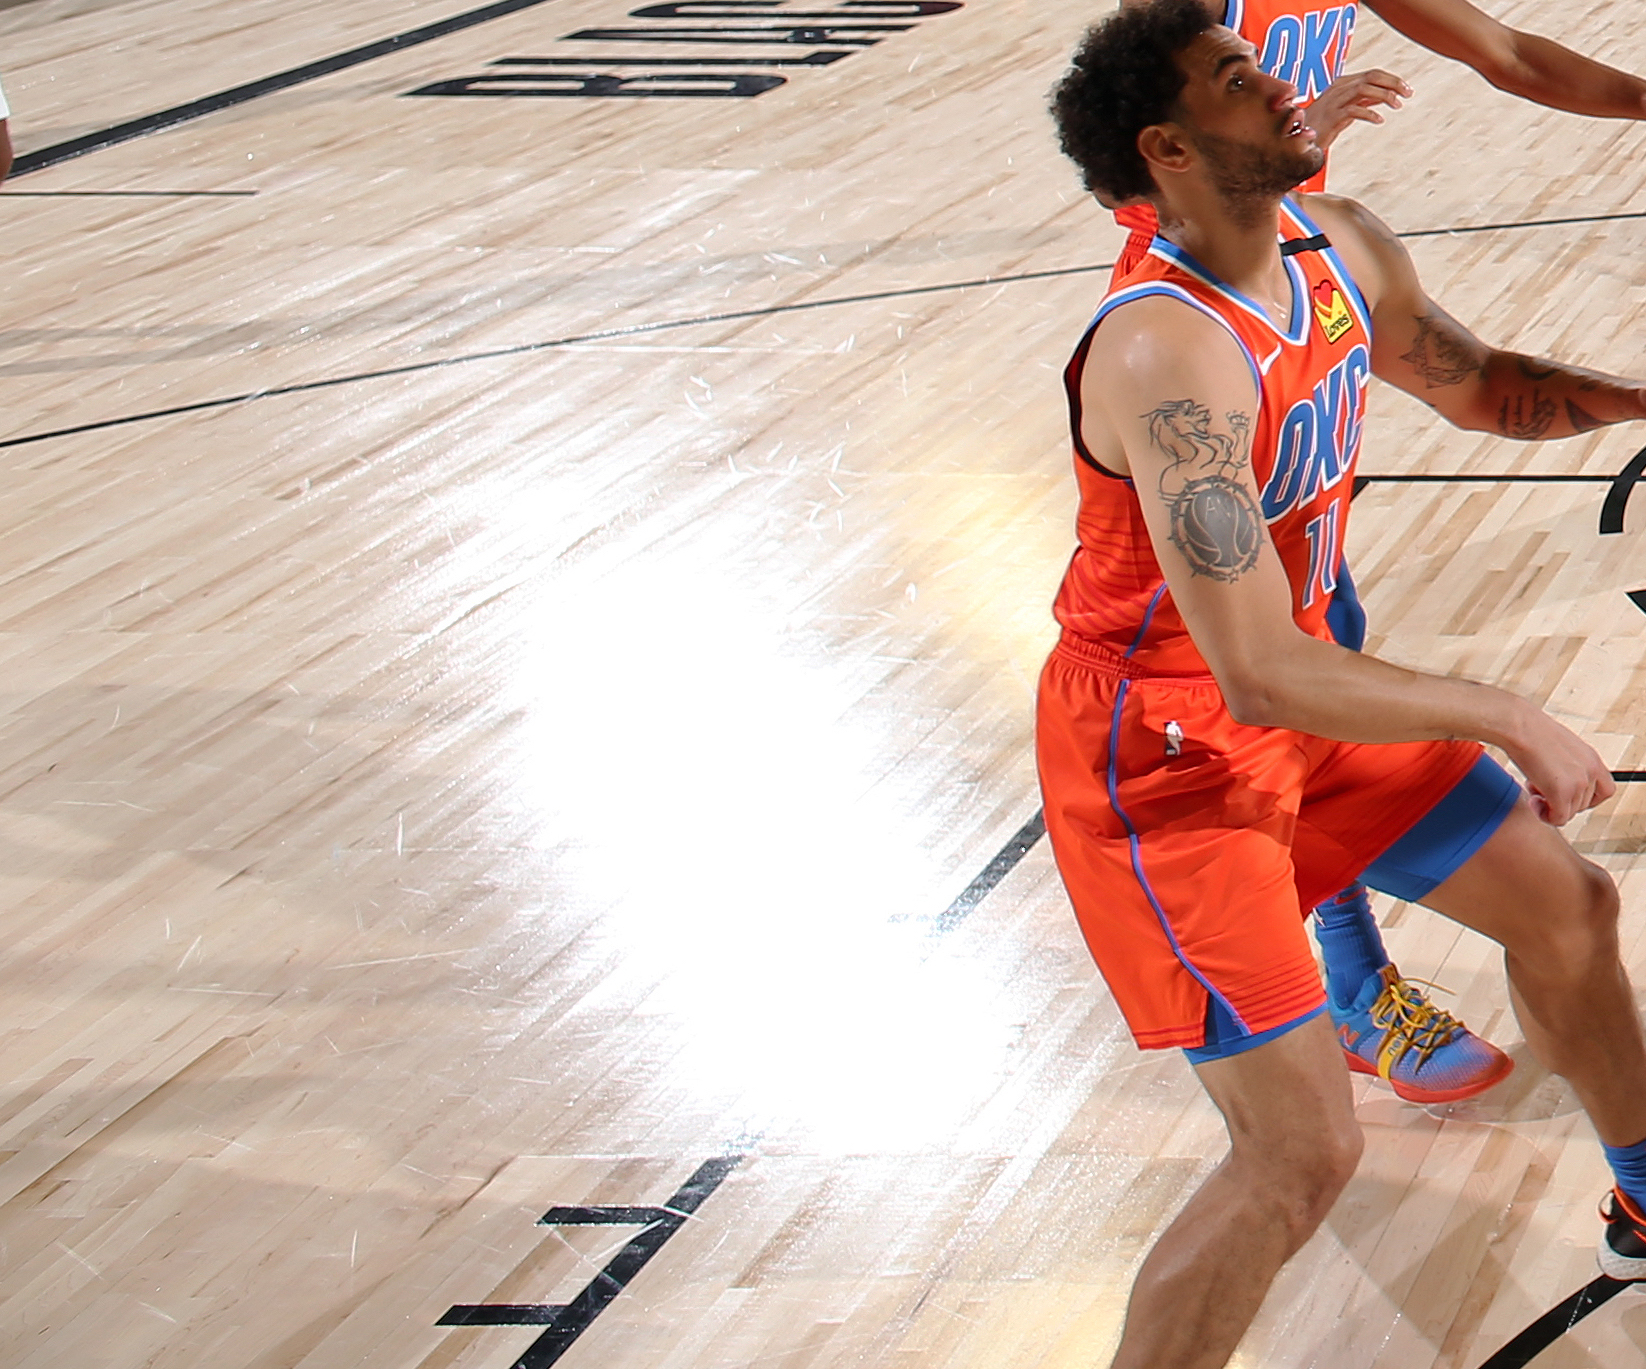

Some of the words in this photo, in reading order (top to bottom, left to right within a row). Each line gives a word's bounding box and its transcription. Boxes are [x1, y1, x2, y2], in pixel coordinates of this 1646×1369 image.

[1257, 2, 1358, 106] OKC
[1257, 342, 1371, 528] OKC
[1302, 496, 1342, 612] 11
